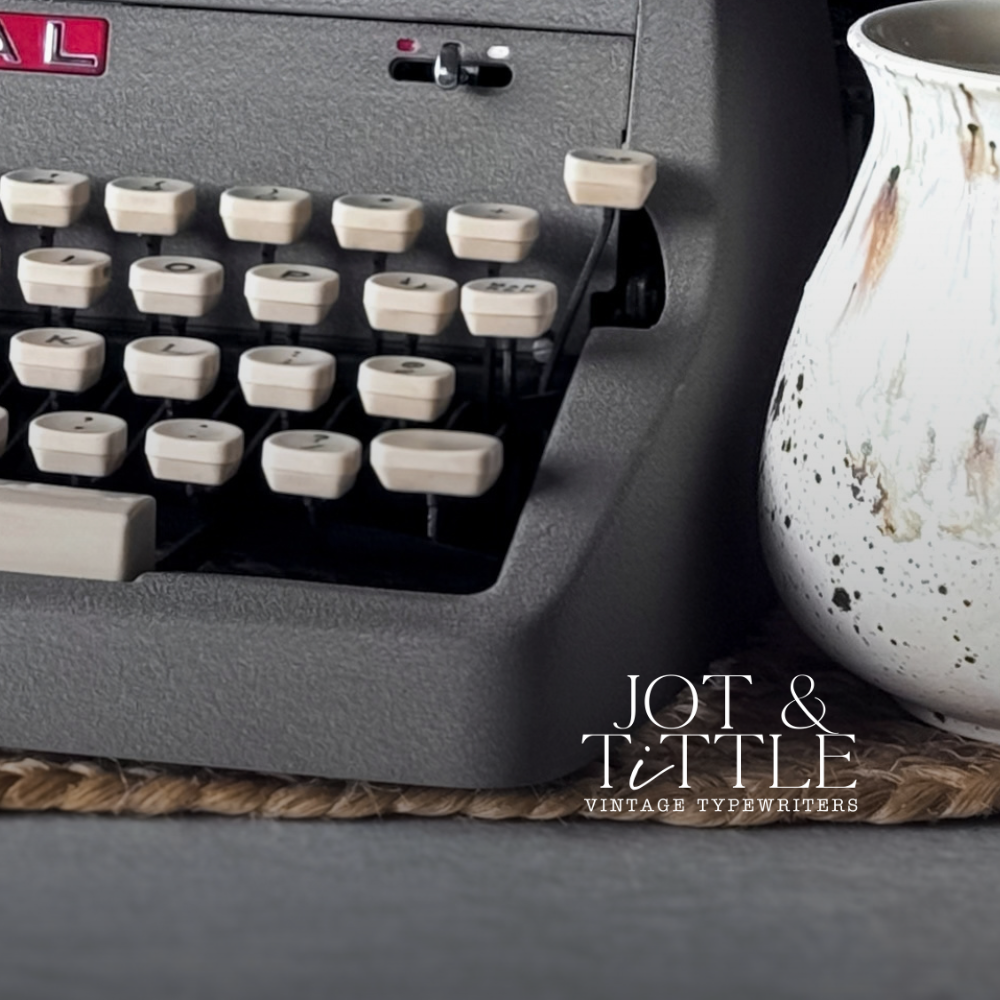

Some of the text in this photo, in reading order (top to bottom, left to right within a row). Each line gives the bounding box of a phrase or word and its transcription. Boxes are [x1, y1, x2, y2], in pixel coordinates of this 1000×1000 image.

[165, 262, 196, 272] O
[280, 269, 311, 280] P
[45, 334, 77, 346] K
